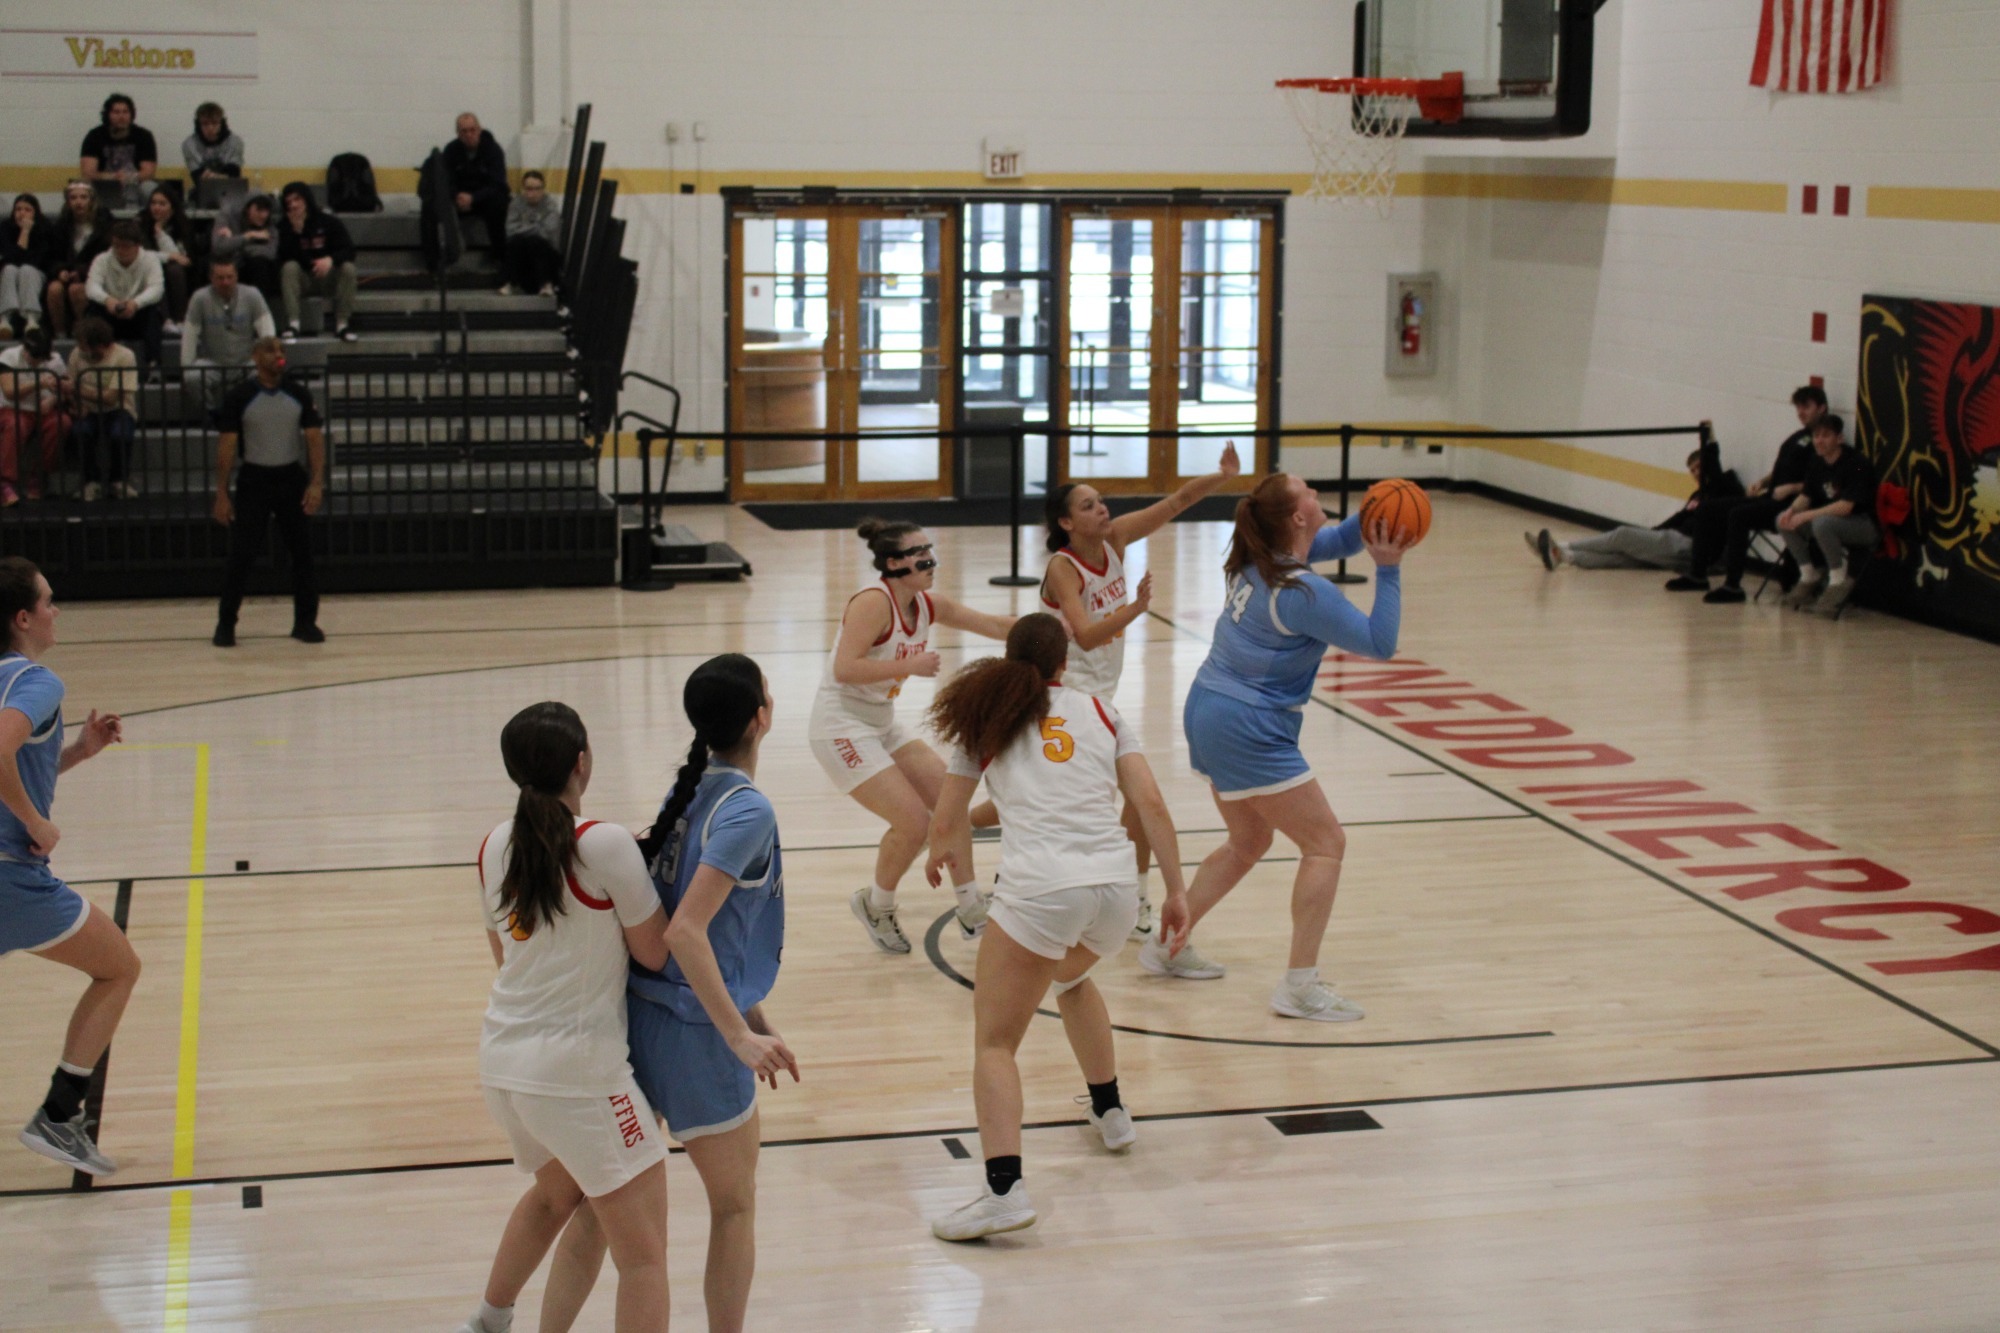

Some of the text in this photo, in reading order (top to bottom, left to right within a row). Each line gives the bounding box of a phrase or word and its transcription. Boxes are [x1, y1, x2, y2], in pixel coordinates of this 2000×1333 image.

[64, 37, 196, 69] Visitors
[991, 154, 1019, 175] EXIT
[1039, 716, 1075, 763] 5
